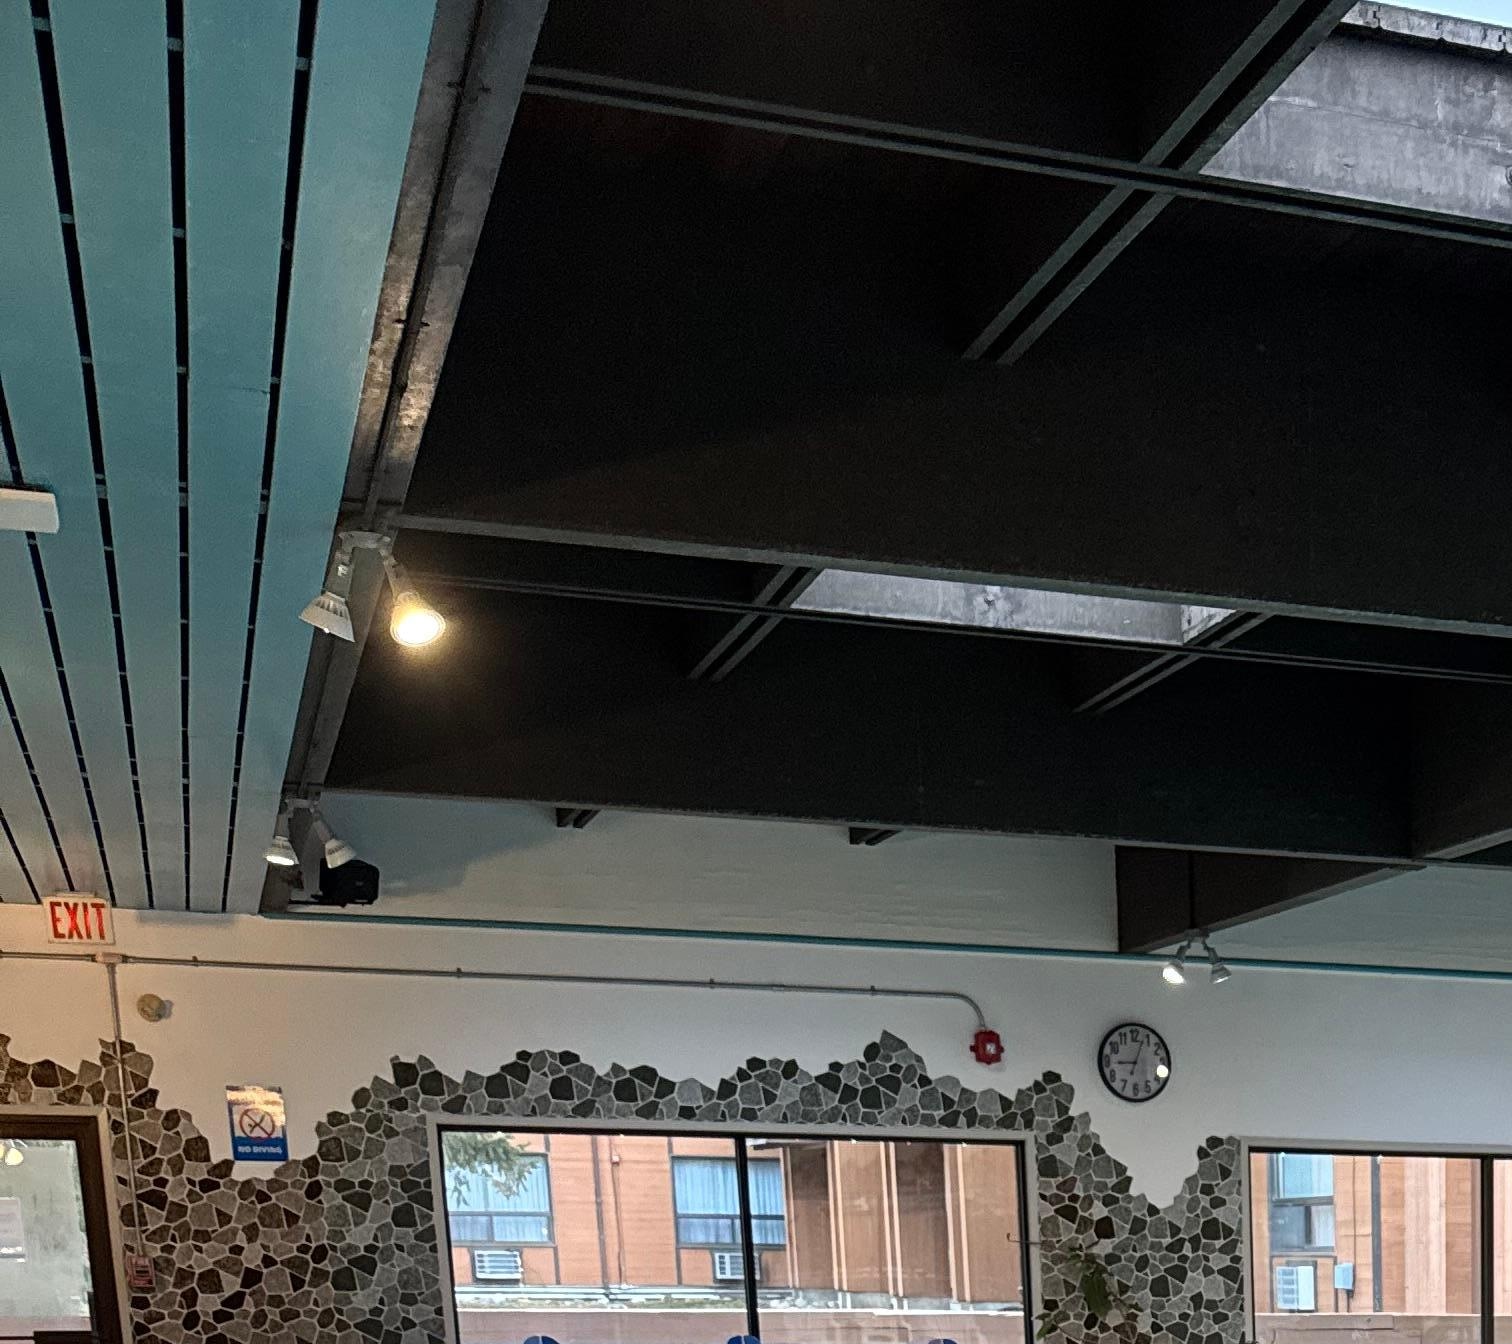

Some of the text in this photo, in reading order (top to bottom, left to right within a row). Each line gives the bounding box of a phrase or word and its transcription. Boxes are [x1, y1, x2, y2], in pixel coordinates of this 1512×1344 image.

[50, 901, 105, 940] EXIT
[1118, 1032, 1127, 1046] 11
[1129, 1028, 1141, 1043] 12
[1145, 1033, 1150, 1047] 1
[1109, 1040, 1119, 1055] 10
[1154, 1042, 1161, 1056] 2
[1109, 1069, 1116, 1083] 8
[1121, 1079, 1127, 1092] 7
[1132, 1083, 1139, 1096] 6
[1144, 1080, 1151, 1093] 5
